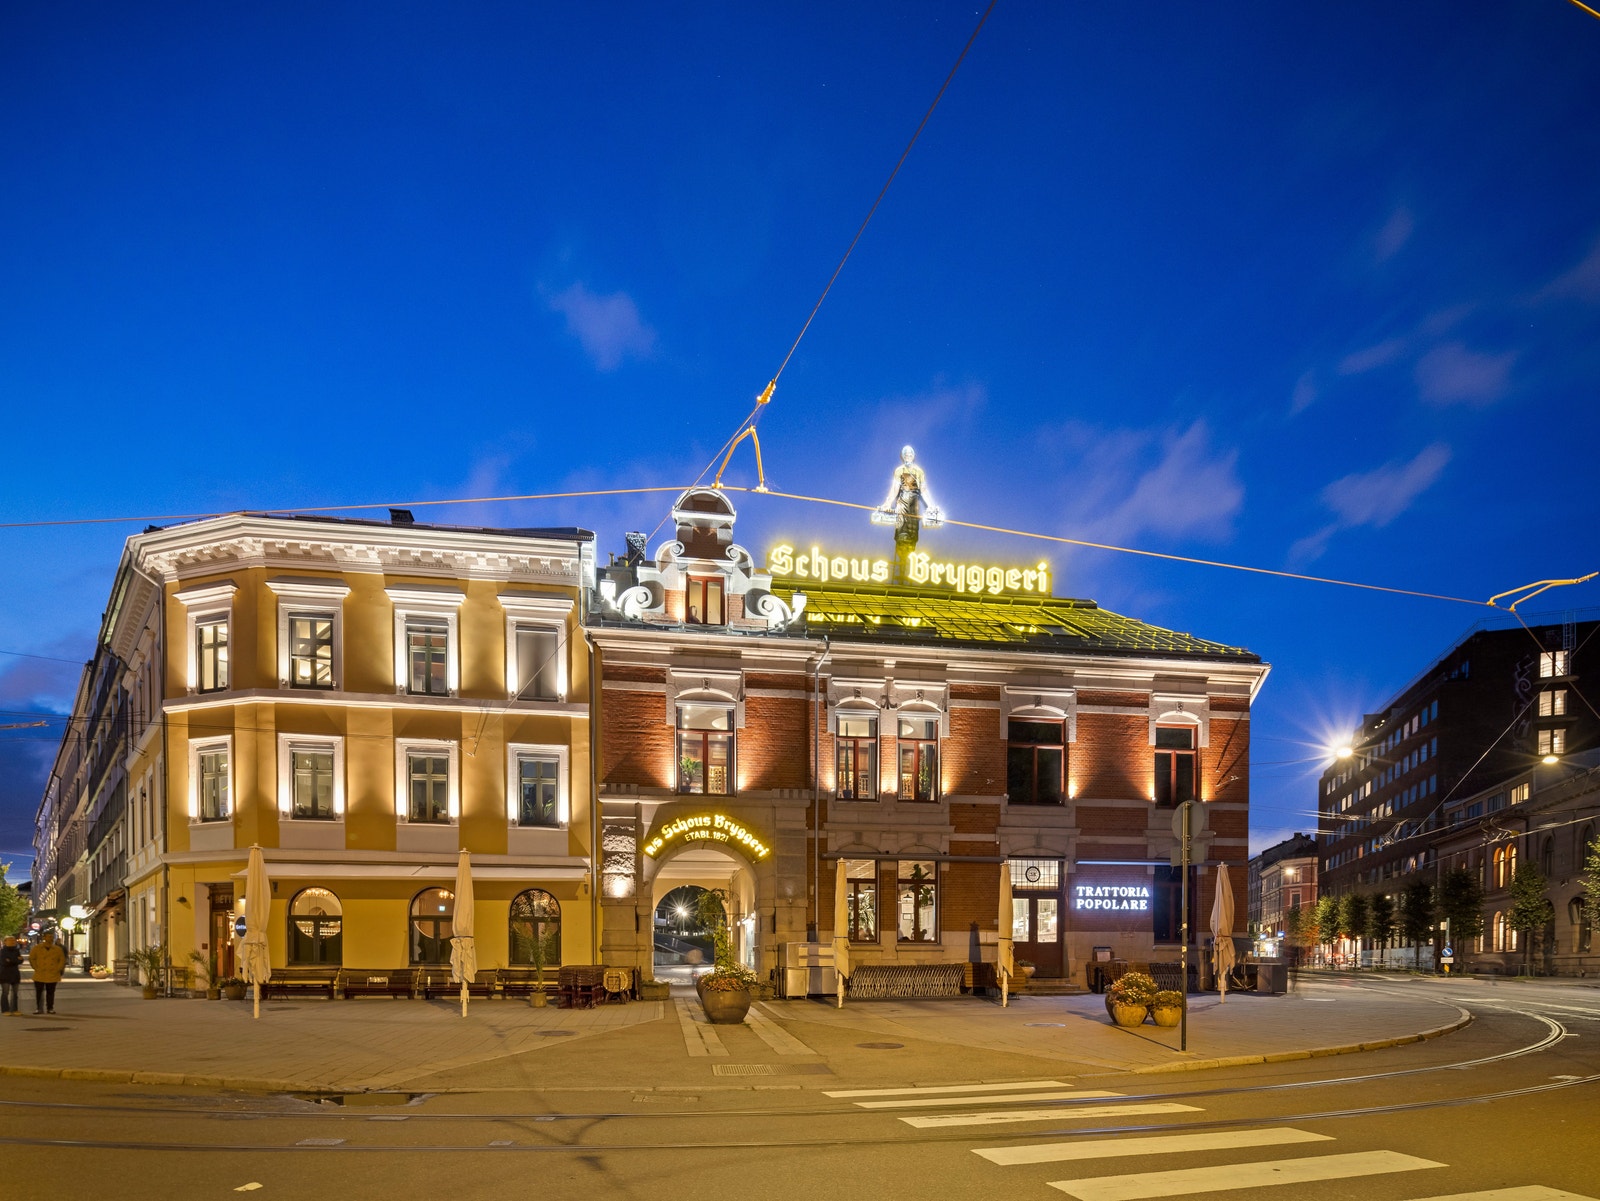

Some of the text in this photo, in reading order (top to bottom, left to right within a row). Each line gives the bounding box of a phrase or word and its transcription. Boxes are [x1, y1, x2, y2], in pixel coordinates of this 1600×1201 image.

[770, 545, 1048, 595] Schous Bryggeri
[661, 817, 711, 840] Schous
[714, 814, 770, 857] Bryggeri
[1076, 886, 1150, 897] TRATTORIA
[1076, 899, 1148, 910] POPOLARE
